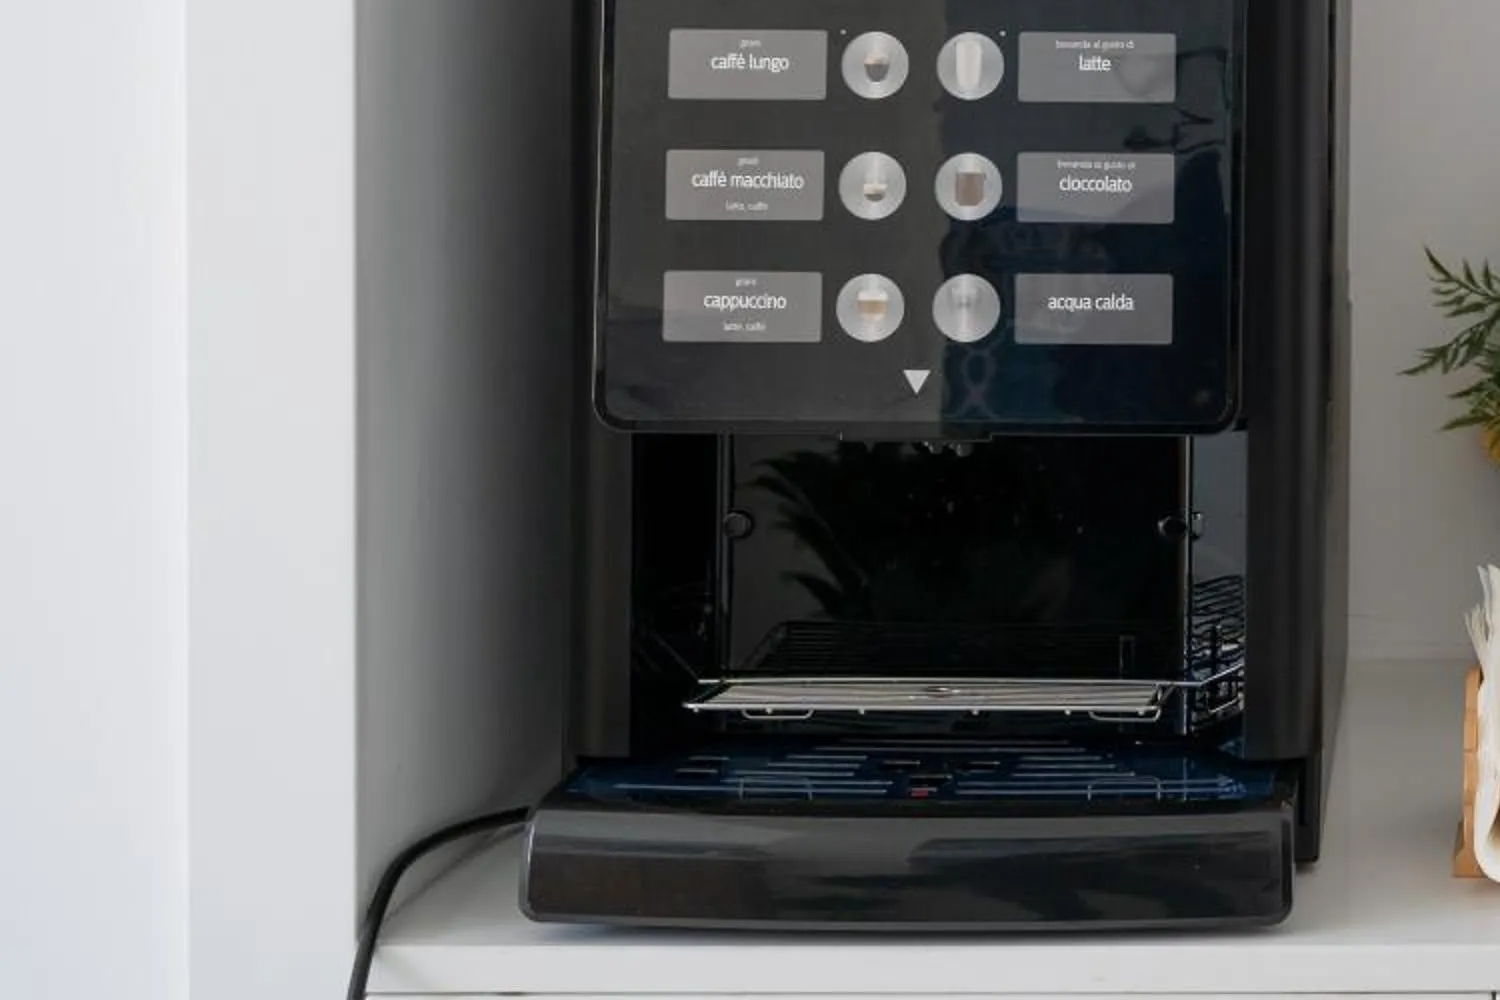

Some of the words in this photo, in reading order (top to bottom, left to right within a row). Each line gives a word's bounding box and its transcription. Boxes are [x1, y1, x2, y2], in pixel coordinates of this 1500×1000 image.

[711, 52, 746, 70] caffè
[749, 53, 789, 73] lungo
[1079, 53, 1112, 72] latte
[691, 169, 727, 188] caffè
[731, 171, 805, 189] macchiato
[1059, 174, 1133, 193] cioccolato
[703, 293, 788, 312] cappuccino
[1047, 296, 1092, 312] acqua
[1095, 291, 1135, 311] calda
